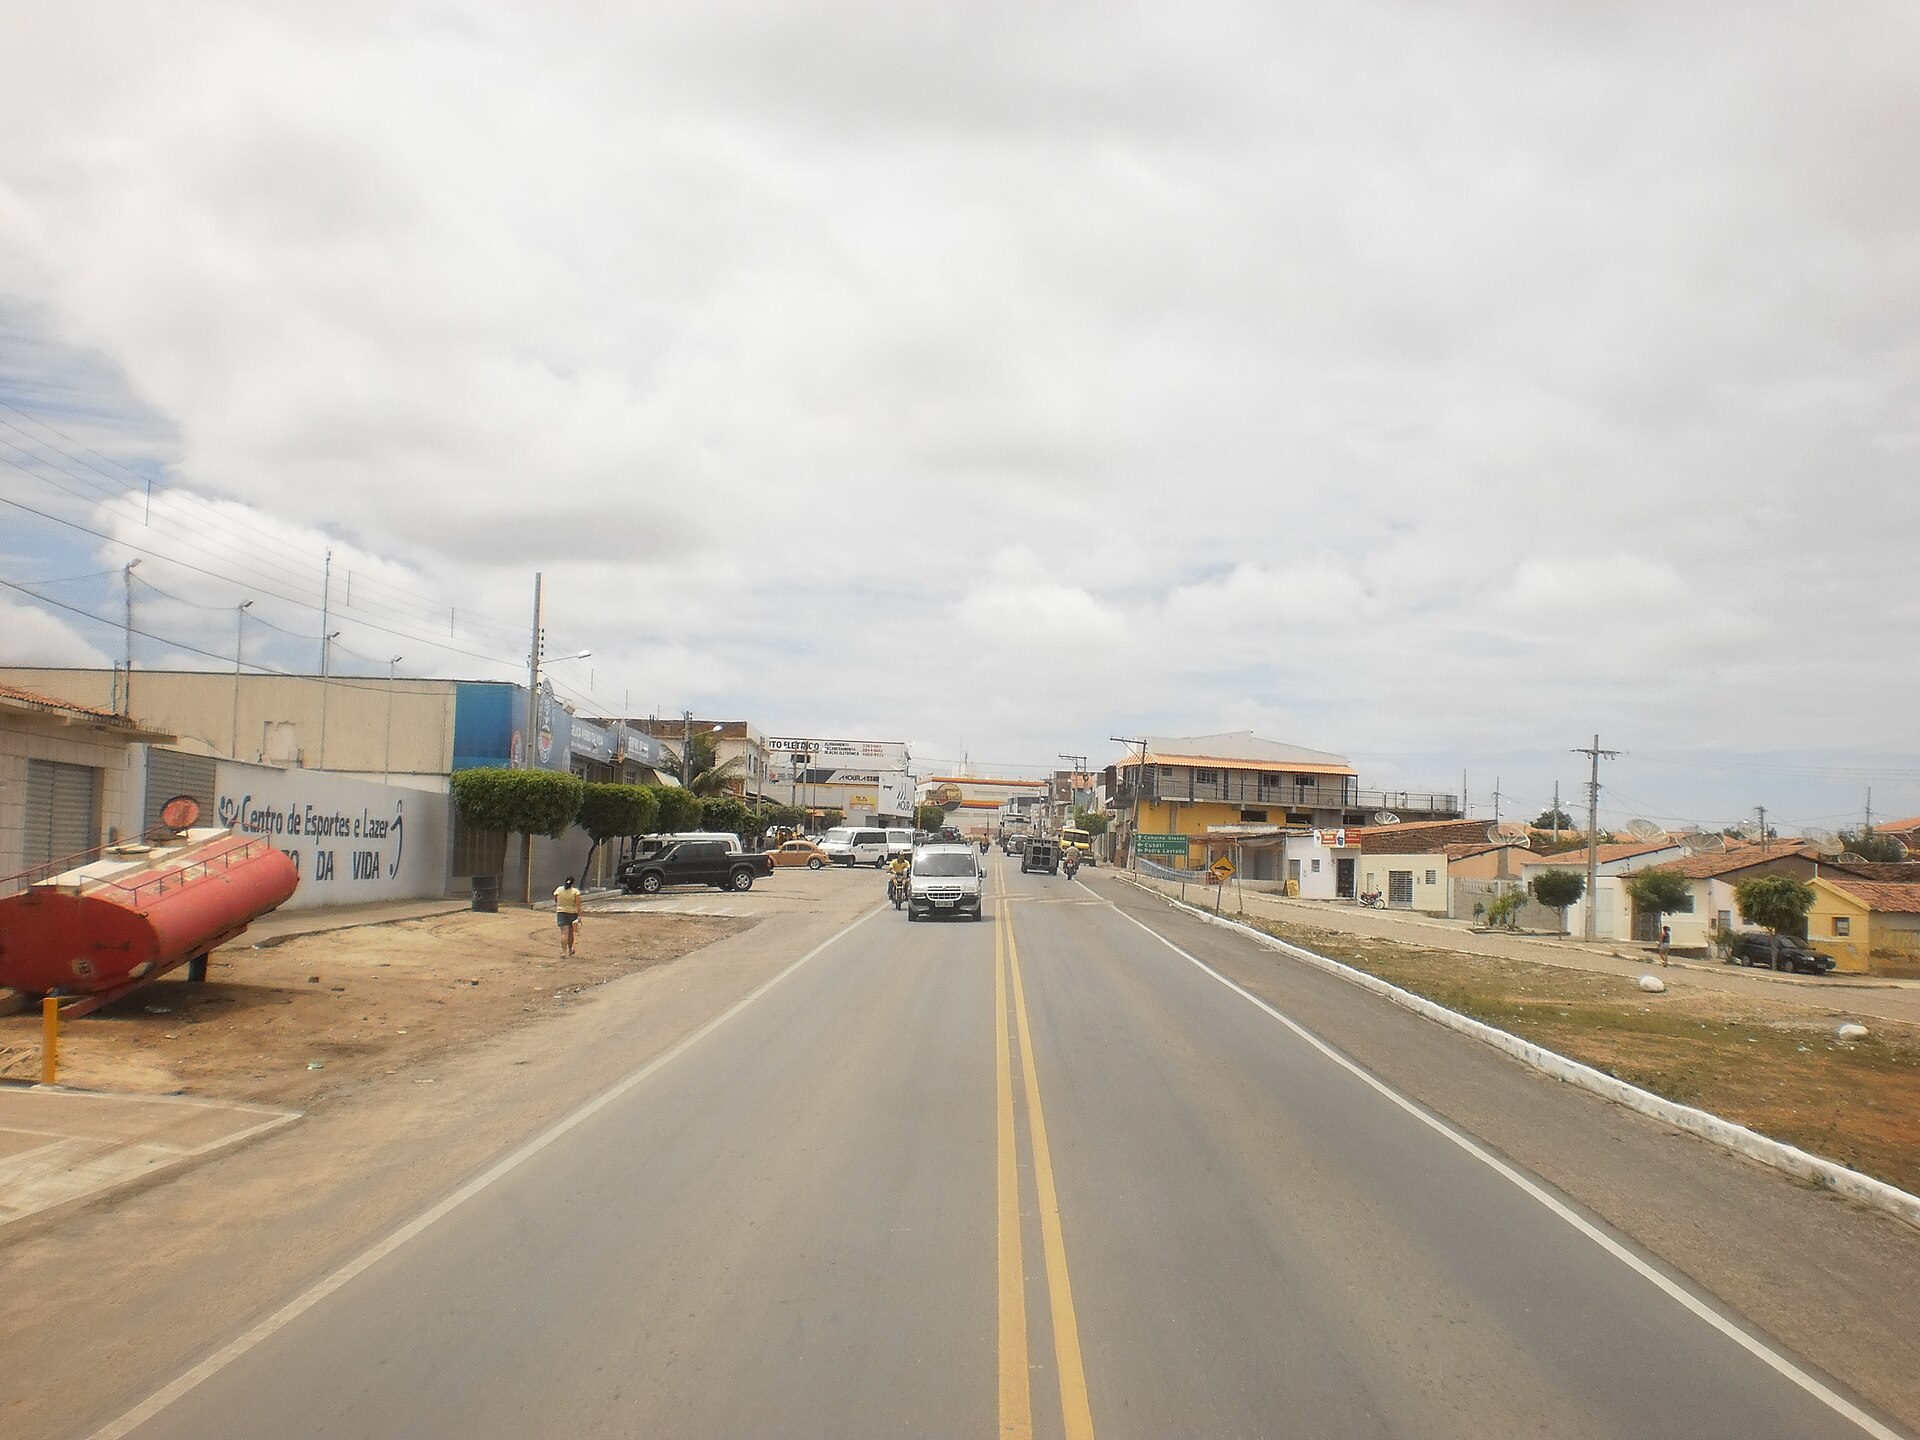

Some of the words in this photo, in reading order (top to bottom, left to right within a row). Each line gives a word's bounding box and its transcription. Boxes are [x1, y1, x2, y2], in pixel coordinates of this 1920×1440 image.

[838, 774, 866, 782] MOURA
[241, 795, 282, 834] Centro
[287, 803, 300, 835] de
[304, 805, 350, 845] Esportes
[354, 818, 360, 836] e
[363, 808, 389, 839] Lazer
[315, 850, 334, 881] DA
[353, 851, 379, 880] VIDA
